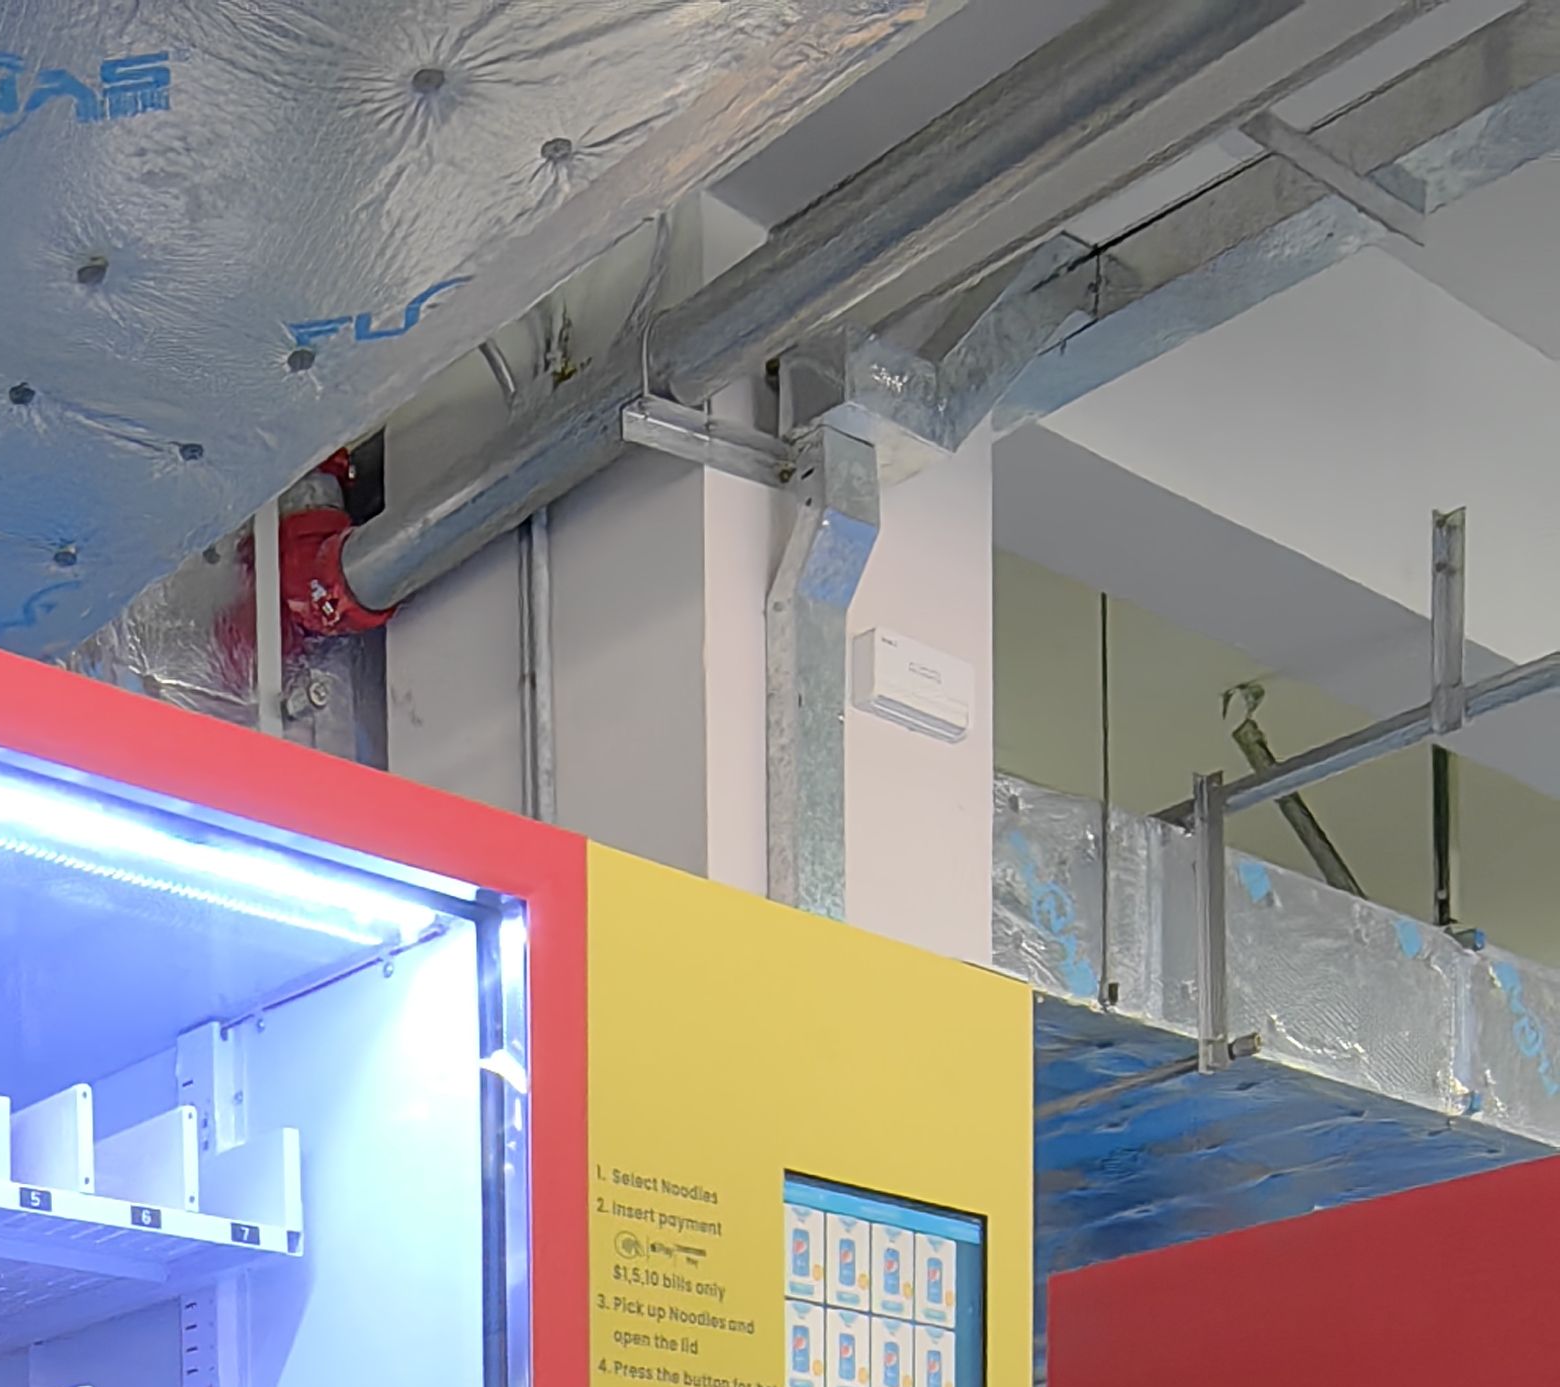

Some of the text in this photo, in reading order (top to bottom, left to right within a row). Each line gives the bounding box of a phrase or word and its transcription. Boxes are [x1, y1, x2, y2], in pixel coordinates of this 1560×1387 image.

[597, 1164, 718, 1204] 1. Select Noodles
[597, 1198, 722, 1237] 2. Insert payment
[663, 1273, 692, 1292] bills
[695, 1282, 726, 1302] only
[597, 1293, 755, 1335] 3. Pick up Noodles and
[614, 1330, 698, 1355] open the lid
[598, 1358, 611, 1373] 4.
[614, 1361, 653, 1380] Press
[657, 1368, 679, 1384] the
